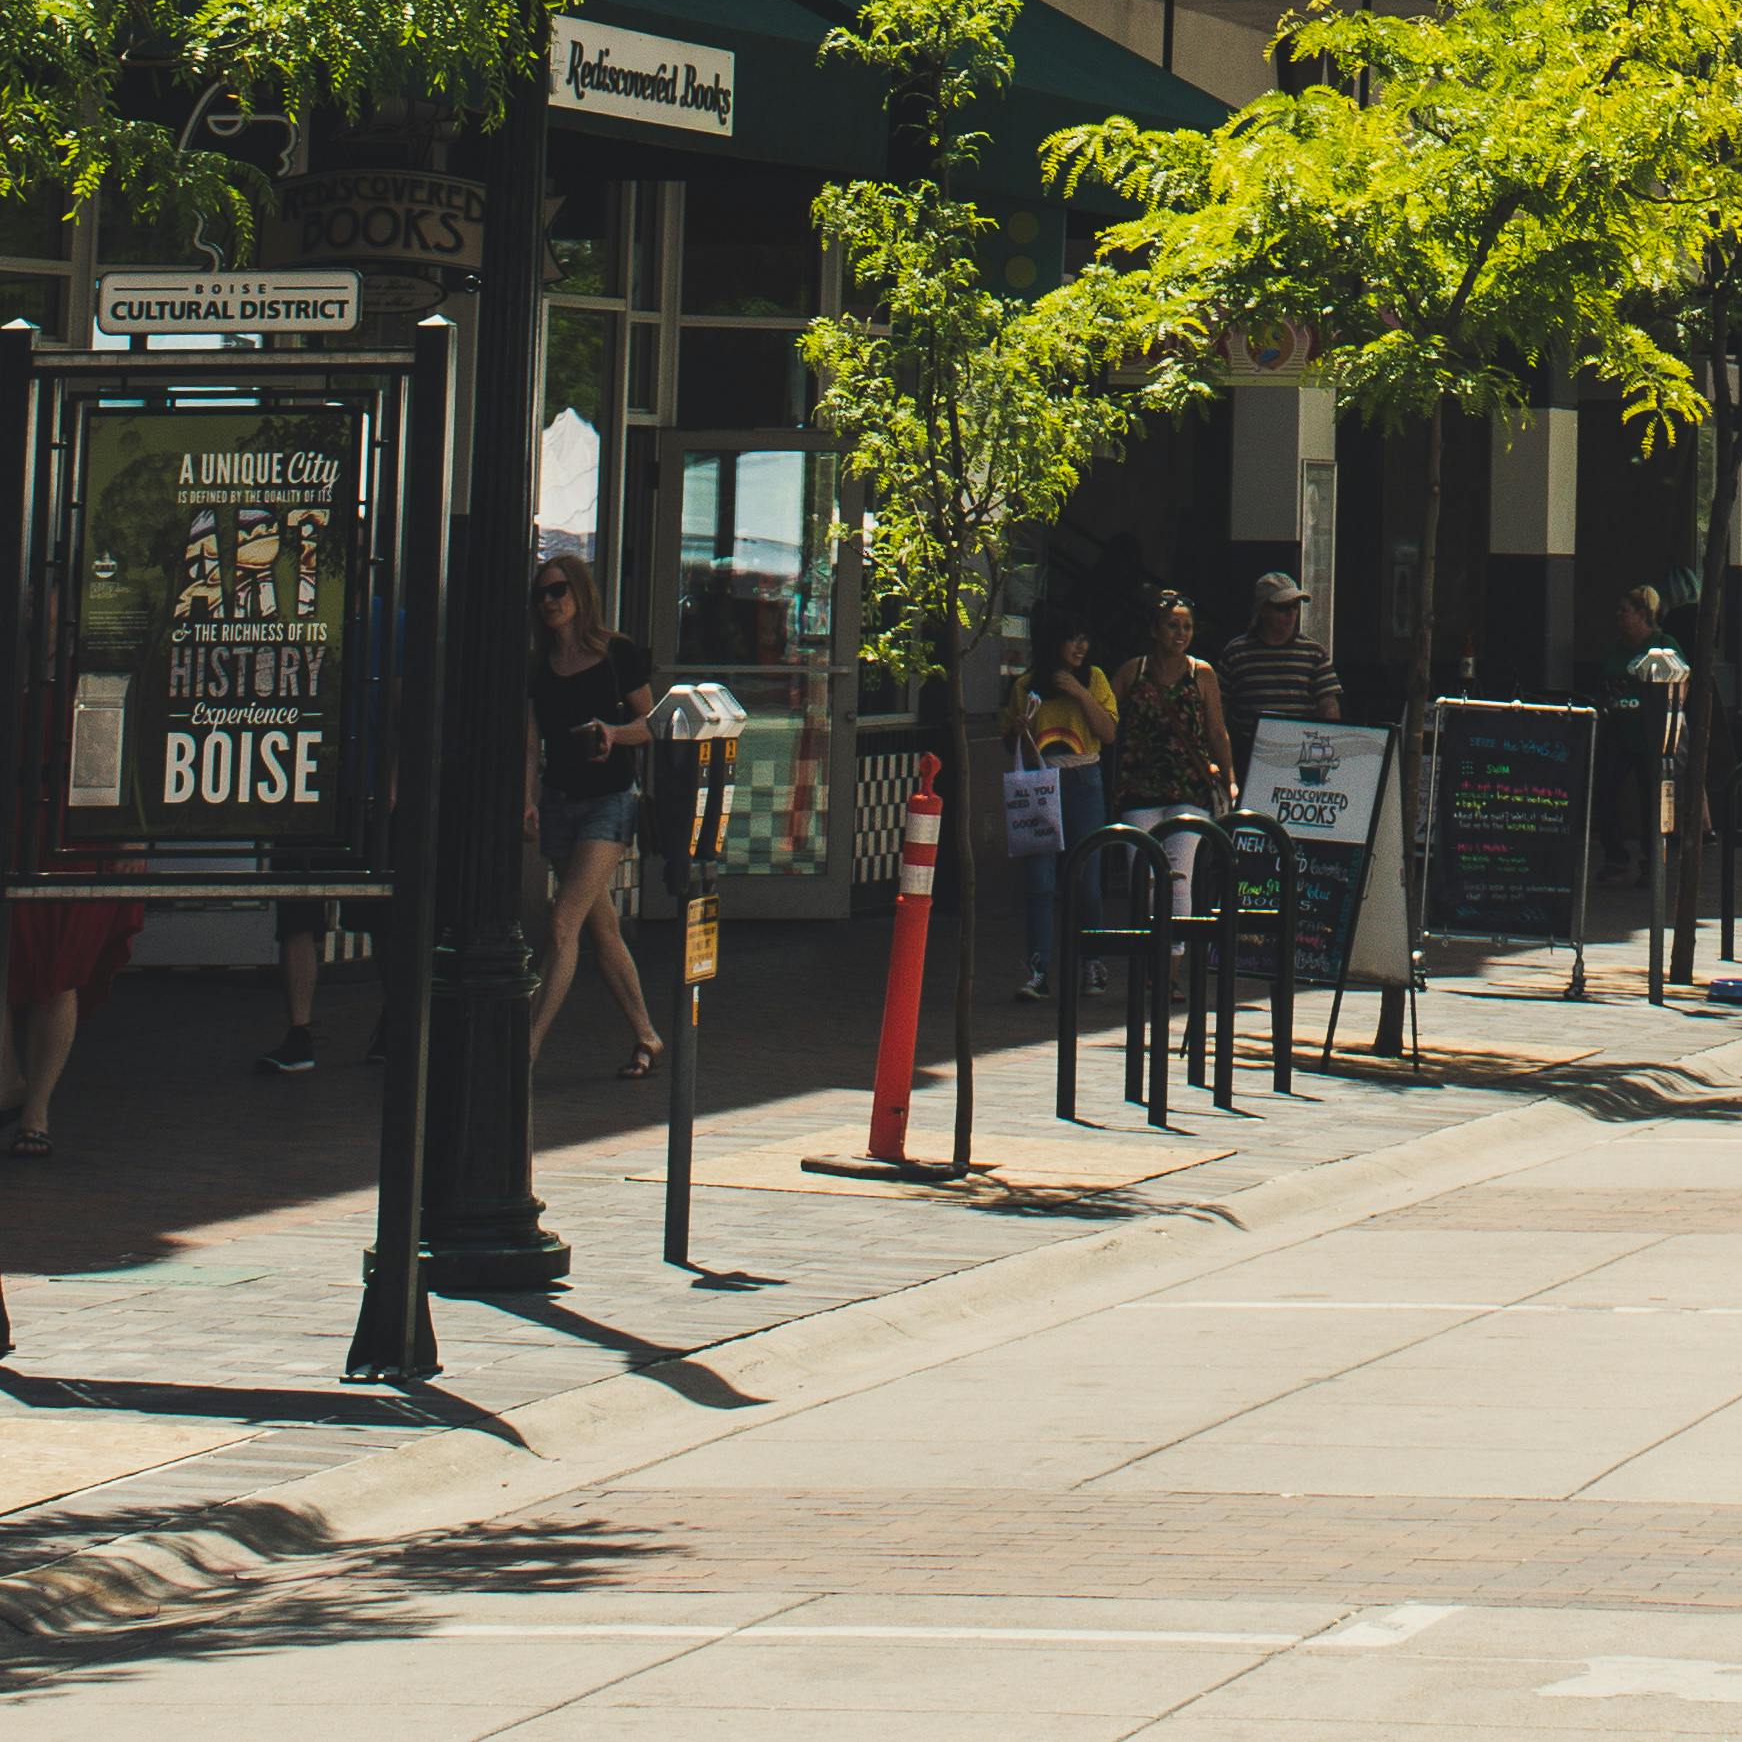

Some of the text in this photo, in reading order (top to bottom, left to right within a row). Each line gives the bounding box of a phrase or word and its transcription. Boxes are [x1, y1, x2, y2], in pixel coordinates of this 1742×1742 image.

[566, 39, 732, 125] Rediscovered Books
[302, 206, 464, 254] BOOKS
[195, 283, 267, 295] BOISE
[110, 299, 350, 321] CULTURAL DISTRICT
[178, 451, 341, 491] A UNIQUE City
[178, 489, 333, 504] IS DEFINED BY THE QUALITY OF ITS
[174, 508, 330, 619] ART
[171, 622, 192, 642] &
[194, 623, 218, 641] THE
[221, 622, 284, 641] RICHNESS
[287, 622, 304, 641] OF
[306, 622, 328, 641] ITS
[169, 646, 326, 698] HISTORY
[191, 701, 300, 734] Experience
[163, 730, 323, 804] BOISE
[1271, 786, 1349, 811] REDISCOVERED
[1277, 801, 1337, 824] BOOKS
[1237, 835, 1264, 853] NEW
